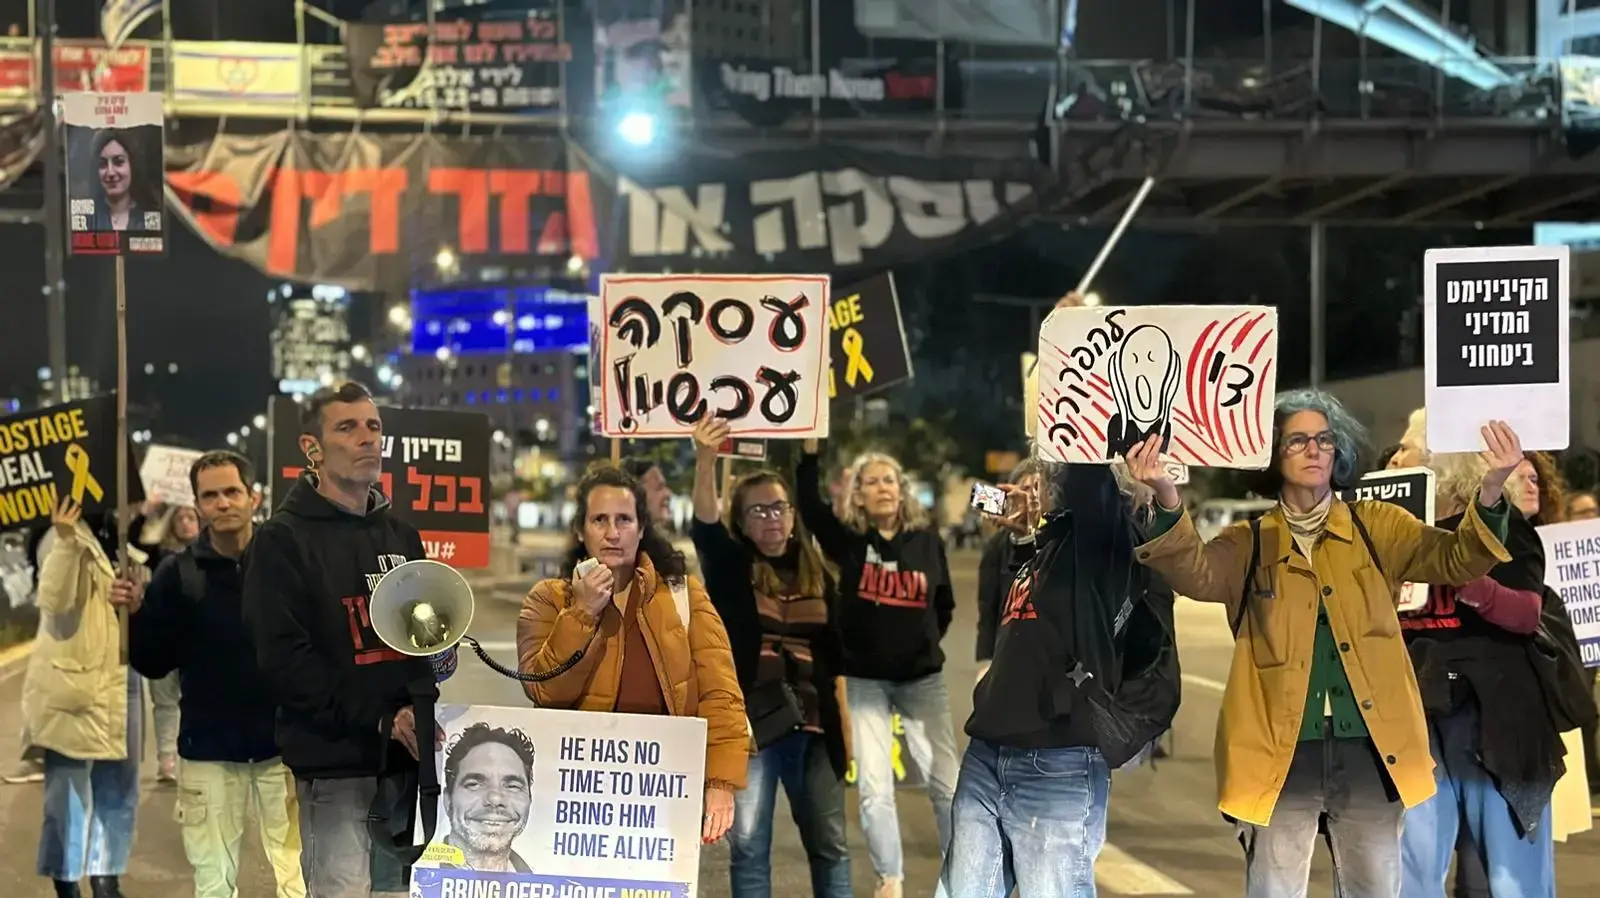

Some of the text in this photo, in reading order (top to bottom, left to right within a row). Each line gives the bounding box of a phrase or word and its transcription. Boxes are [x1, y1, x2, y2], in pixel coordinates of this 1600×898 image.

[720, 62, 770, 101] ring
[1447, 278, 1549, 306] הקיבינימט
[609, 291, 811, 369] עסקה
[1465, 311, 1530, 335] המדיני
[1462, 343, 1534, 368] ביטחוני
[613, 352, 802, 434] עכשיו!
[0, 408, 89, 454] OSTAGE
[401, 436, 462, 463] פדיון
[0, 482, 56, 525] NOW
[407, 466, 484, 513] בכל
[1554, 541, 1573, 560] HE
[1557, 562, 1590, 582] TIME
[1560, 582, 1600, 604] BRING
[560, 737, 660, 765] HE HAS NO
[559, 768, 689, 798] TIME TO WAIT.
[556, 800, 656, 828] BRING HIM
[553, 832, 675, 861] HOME ALIVE!
[441, 878, 500, 898] BRING
